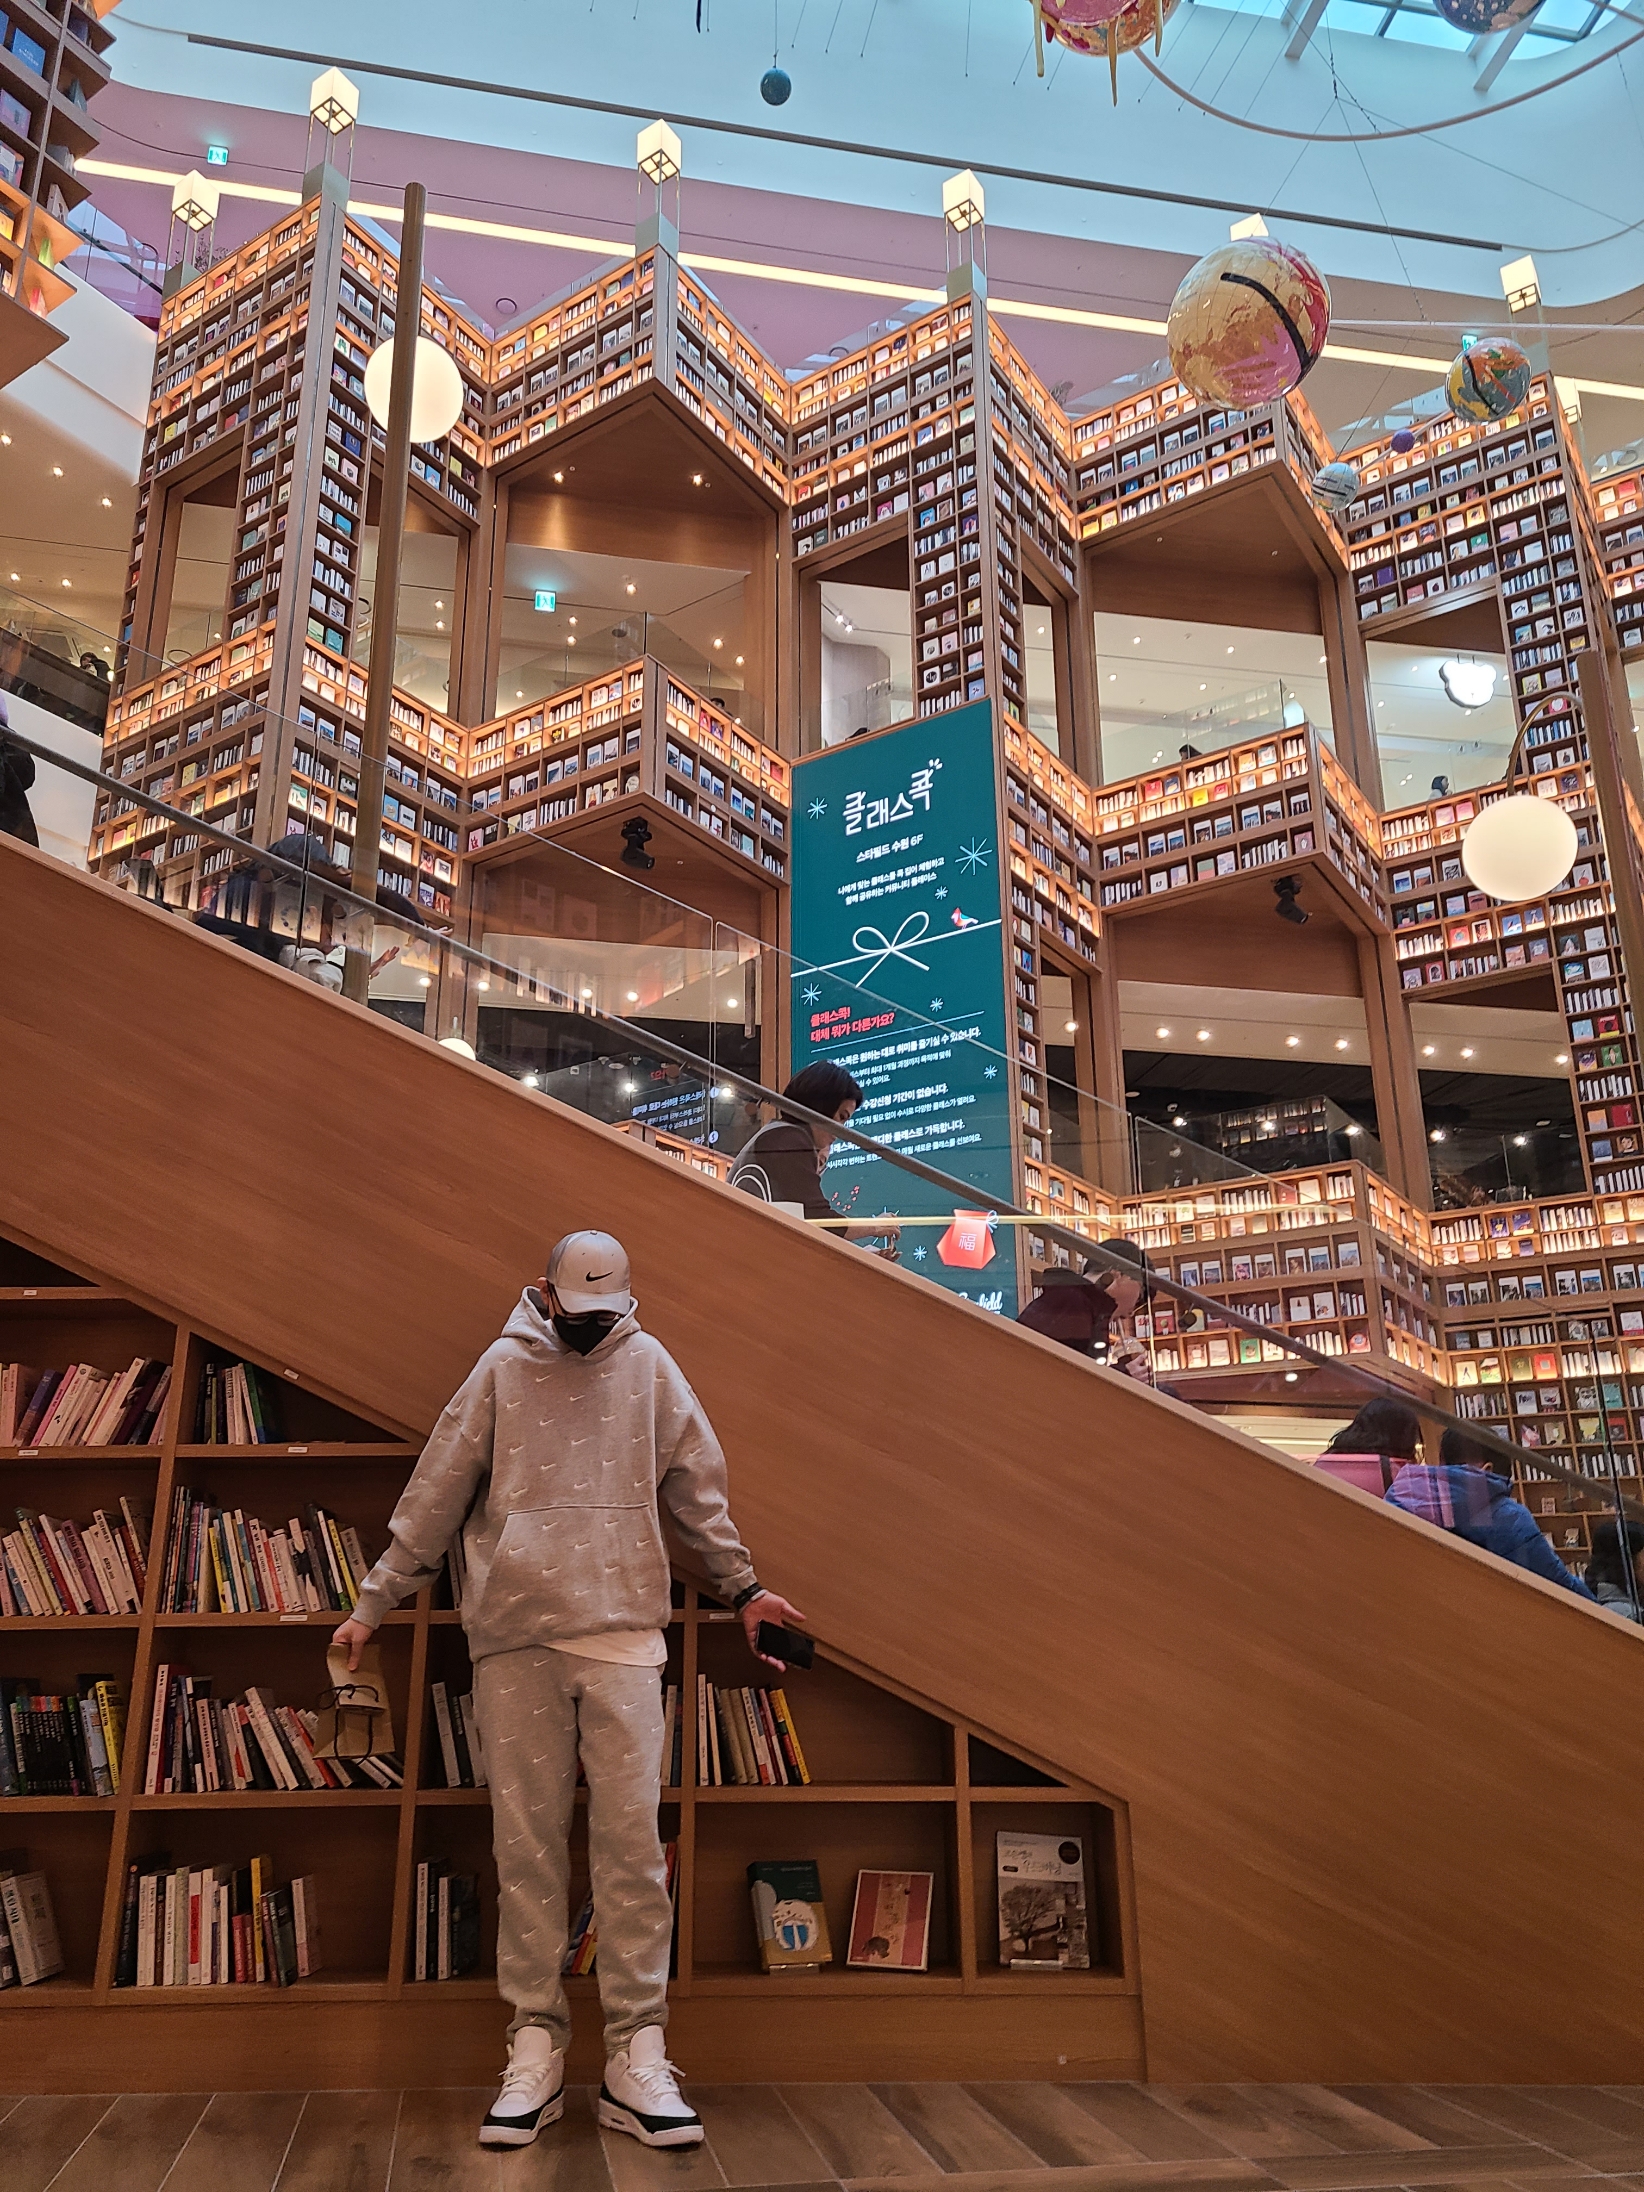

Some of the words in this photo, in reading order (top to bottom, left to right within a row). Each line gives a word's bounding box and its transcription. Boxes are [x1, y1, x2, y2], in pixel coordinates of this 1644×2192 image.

[842, 768, 935, 837] 클래스콕
[855, 843, 891, 863] 스타필드
[891, 836, 910, 853] 수원
[910, 833, 924, 847] 6F
[837, 882, 857, 896] 나에게
[870, 871, 896, 887] 클래스를
[918, 856, 945, 872] 체험하고
[845, 893, 859, 906] 함께
[858, 887, 884, 903] 공유하는
[884, 878, 911, 894] 커뮤니티
[910, 871, 938, 887] 플레이스
[810, 1006, 851, 1028] 클래스콕!
[810, 1026, 830, 1043] 대체
[830, 1021, 851, 1039] 뭐가
[851, 1011, 896, 1033] 다른가요?
[860, 1049, 881, 1063] 원하는
[881, 1045, 896, 1058] 대로
[896, 1040, 918, 1055] 취미를
[918, 1034, 941, 1050] 즐기실
[941, 1032, 950, 1045] 수
[863, 1093, 892, 1111] 수강신청
[892, 1089, 916, 1104] 기간이
[916, 1082, 949, 1100] 없습니다.
[932, 1097, 957, 1112] 클래스가
[893, 1127, 925, 1143] 클래스로
[924, 1118, 966, 1136] 가득합니다.
[958, 1232, 978, 1251] 福
